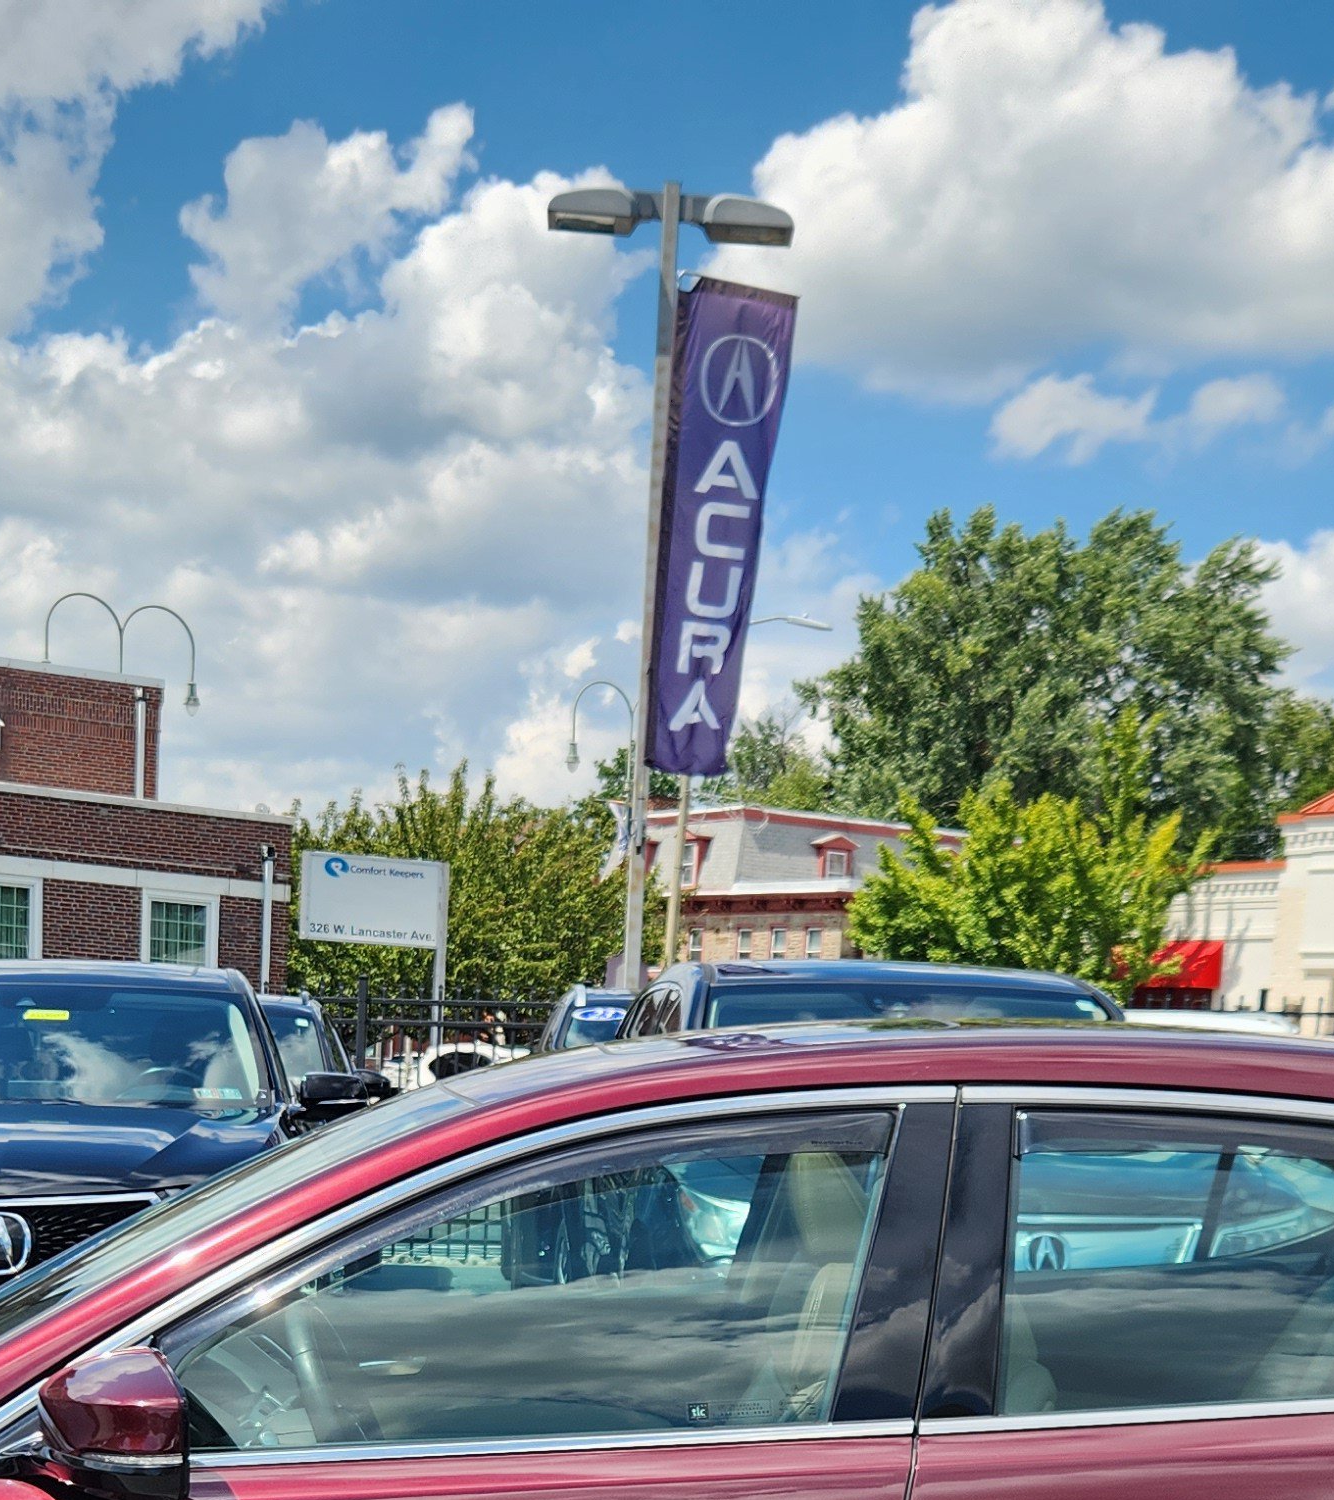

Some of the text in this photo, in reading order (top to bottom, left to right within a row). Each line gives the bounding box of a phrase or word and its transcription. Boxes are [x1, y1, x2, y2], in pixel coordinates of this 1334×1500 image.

[669, 439, 759, 732] ACURA
[350, 865, 424, 879] Comfort Keepers
[309, 923, 435, 942] 326 W. Lancaster Ave.
